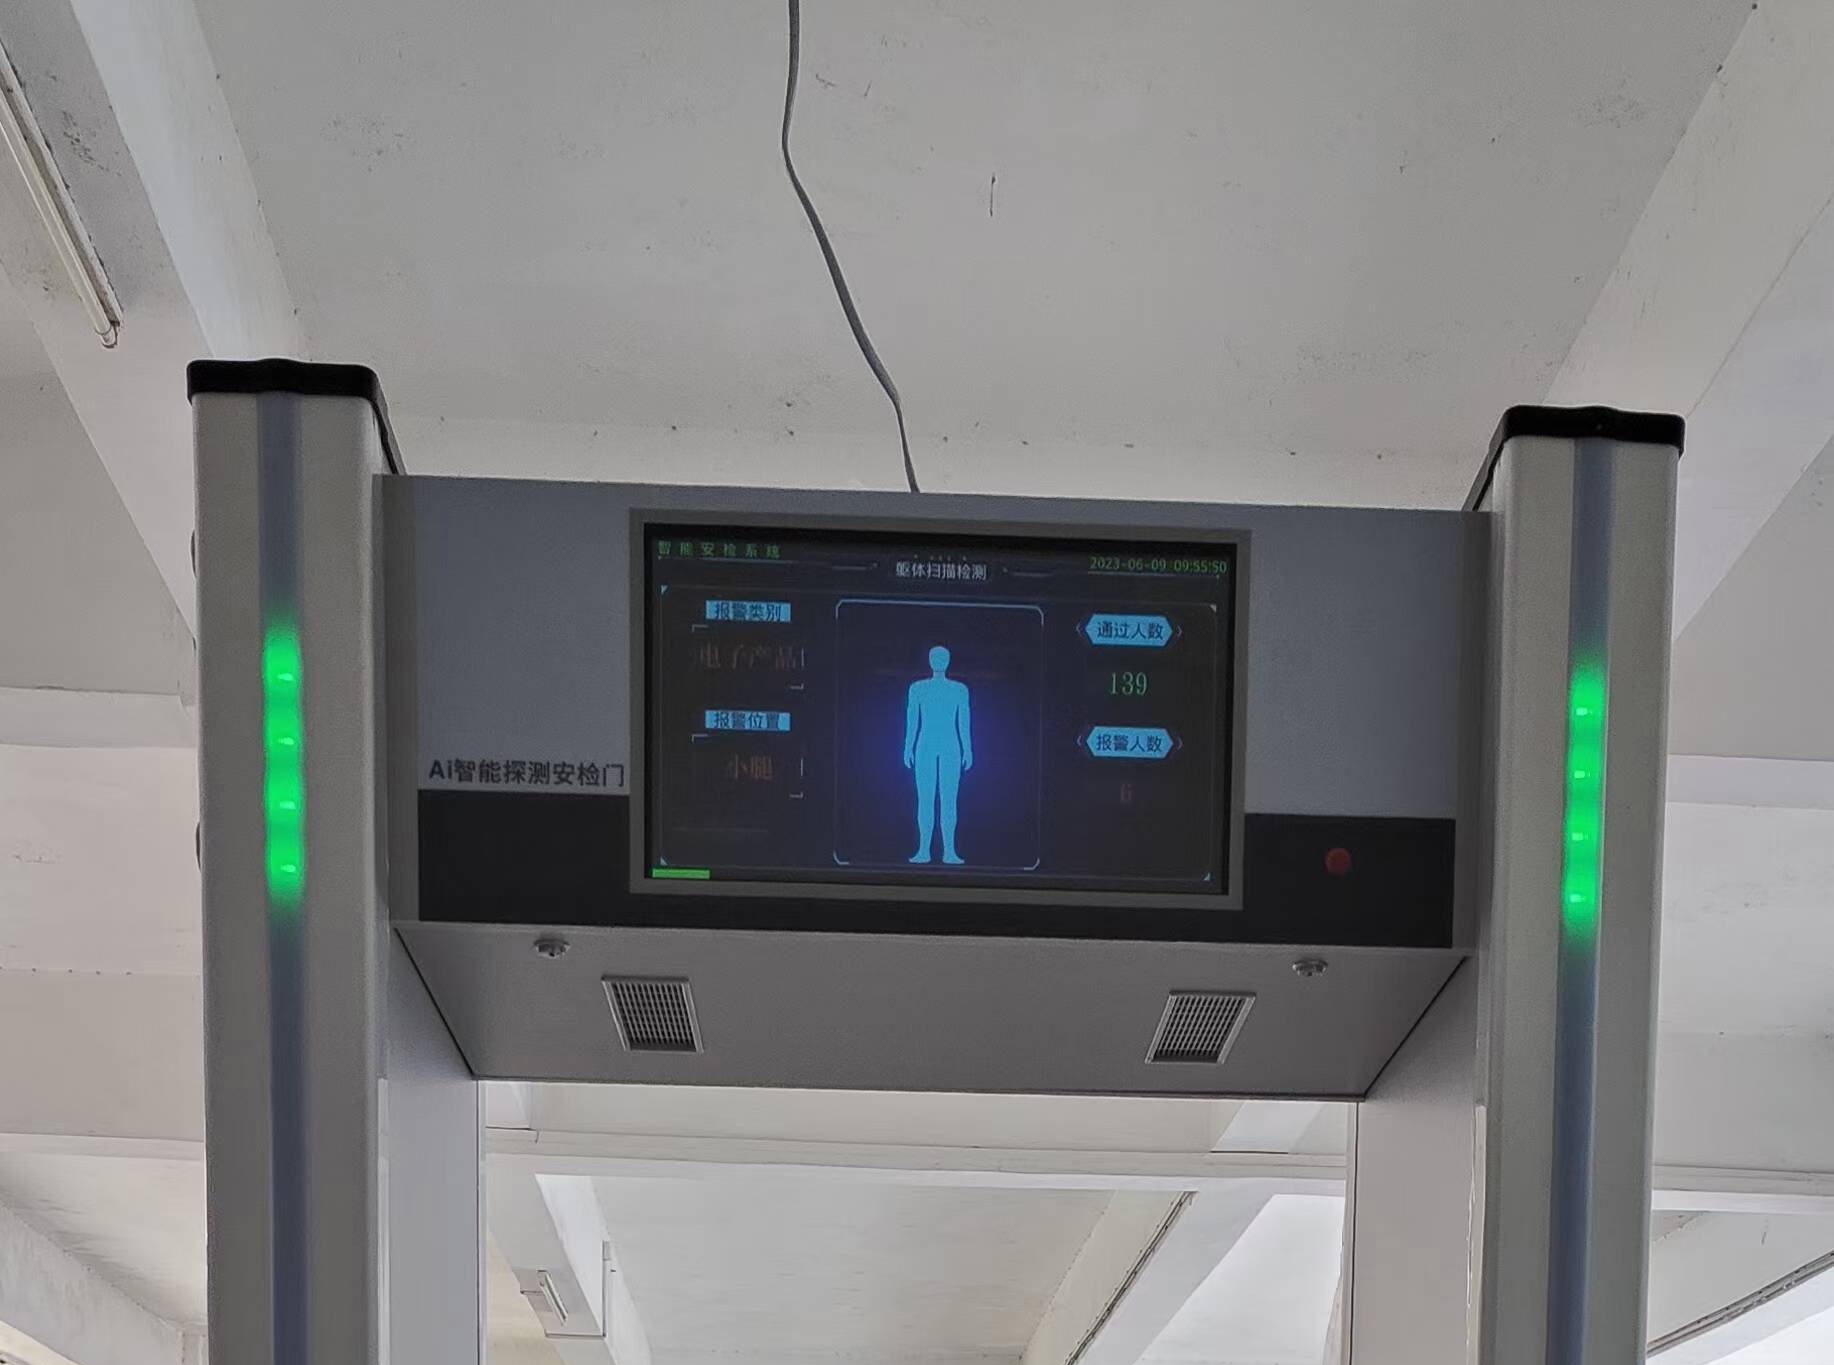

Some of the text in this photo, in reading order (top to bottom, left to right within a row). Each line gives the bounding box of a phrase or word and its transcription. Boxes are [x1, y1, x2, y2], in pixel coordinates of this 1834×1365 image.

[1089, 556, 1167, 572] 2023-06-09
[715, 603, 781, 621] 报警类别
[1097, 620, 1164, 641] 通过人数
[1109, 671, 1148, 696] 139
[1097, 734, 1163, 753] 报警人数
[428, 758, 625, 788] Ai智能探测安检门
